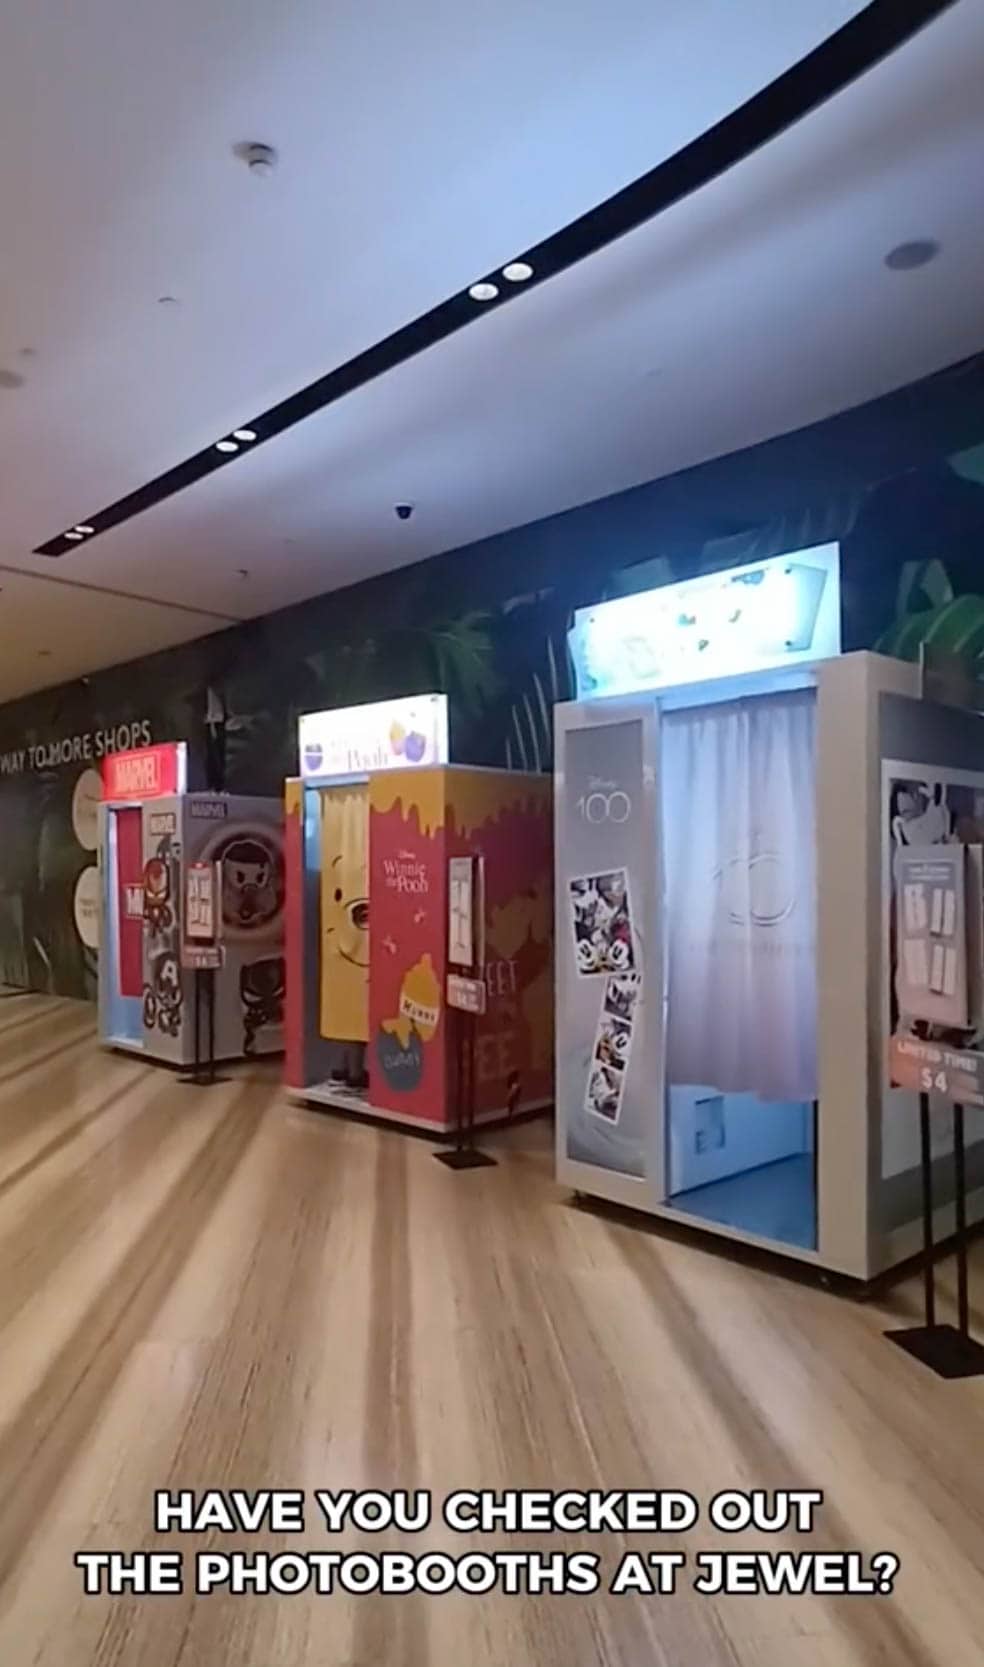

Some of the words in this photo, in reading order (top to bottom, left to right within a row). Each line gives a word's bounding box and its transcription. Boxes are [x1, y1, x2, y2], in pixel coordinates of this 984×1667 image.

[0, 750, 25, 774] WAY
[28, 746, 49, 768] TO
[50, 734, 92, 767] MORE
[95, 719, 151, 757] SHOPS
[114, 754, 159, 794] MARVEL
[576, 791, 632, 824] 100
[383, 859, 427, 878] Winnie
[397, 872, 430, 893] Pooh
[921, 1067, 948, 1093] $4
